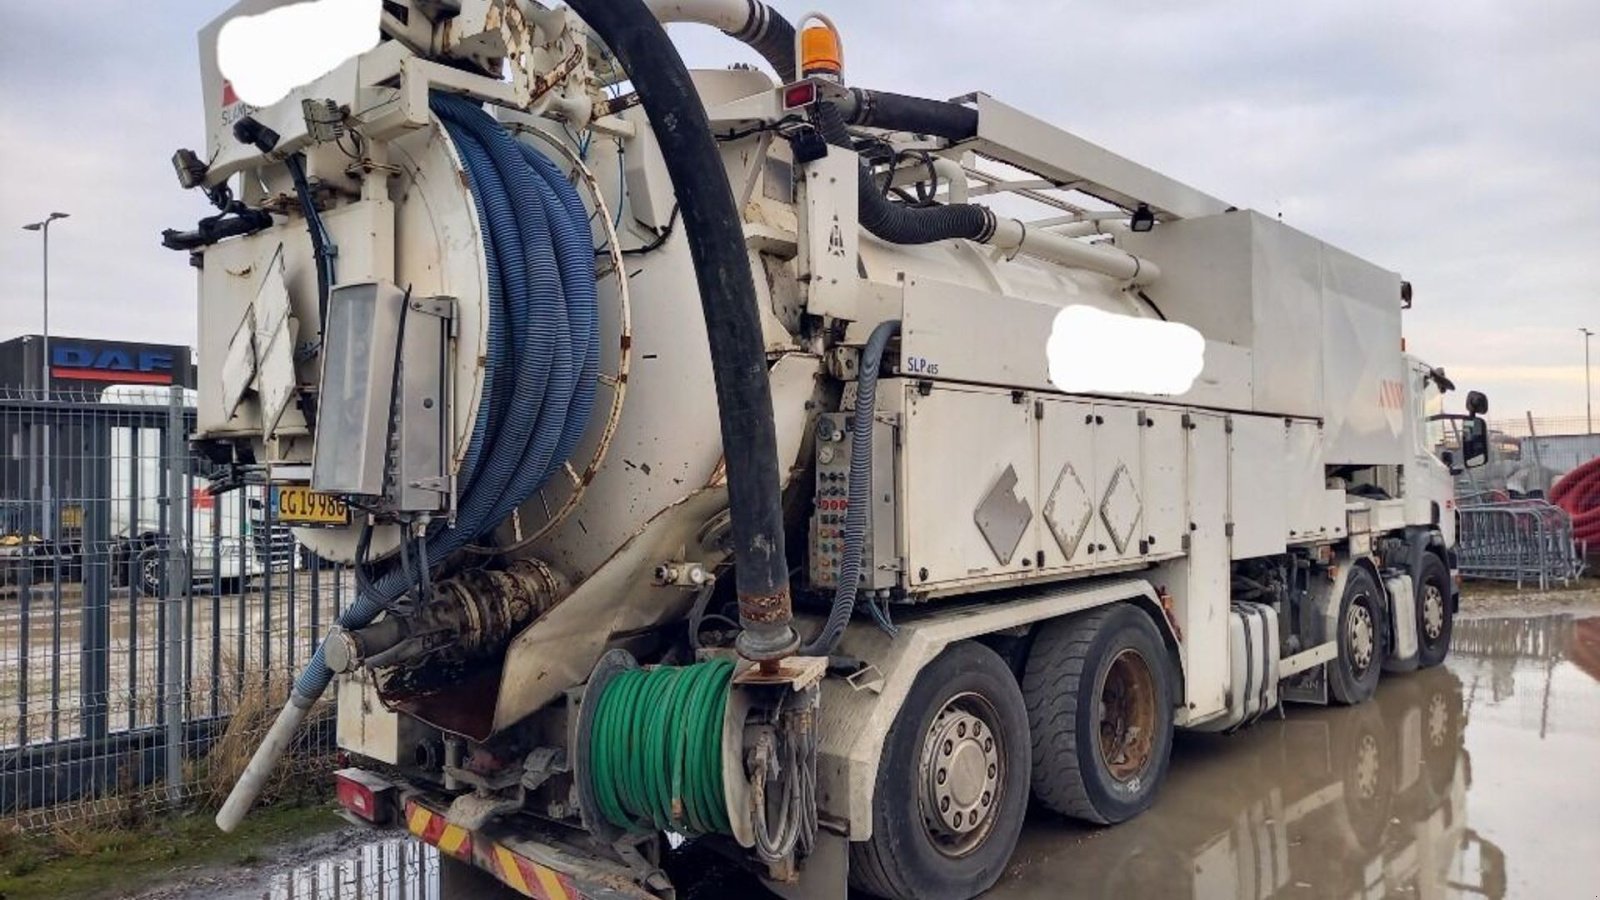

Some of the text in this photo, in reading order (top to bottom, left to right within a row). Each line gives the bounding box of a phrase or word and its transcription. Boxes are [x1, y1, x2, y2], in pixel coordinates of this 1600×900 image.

[52, 346, 173, 371] DAF
[907, 356, 926, 373] SLP
[280, 490, 297, 515] CG
[300, 490, 315, 516] 19
